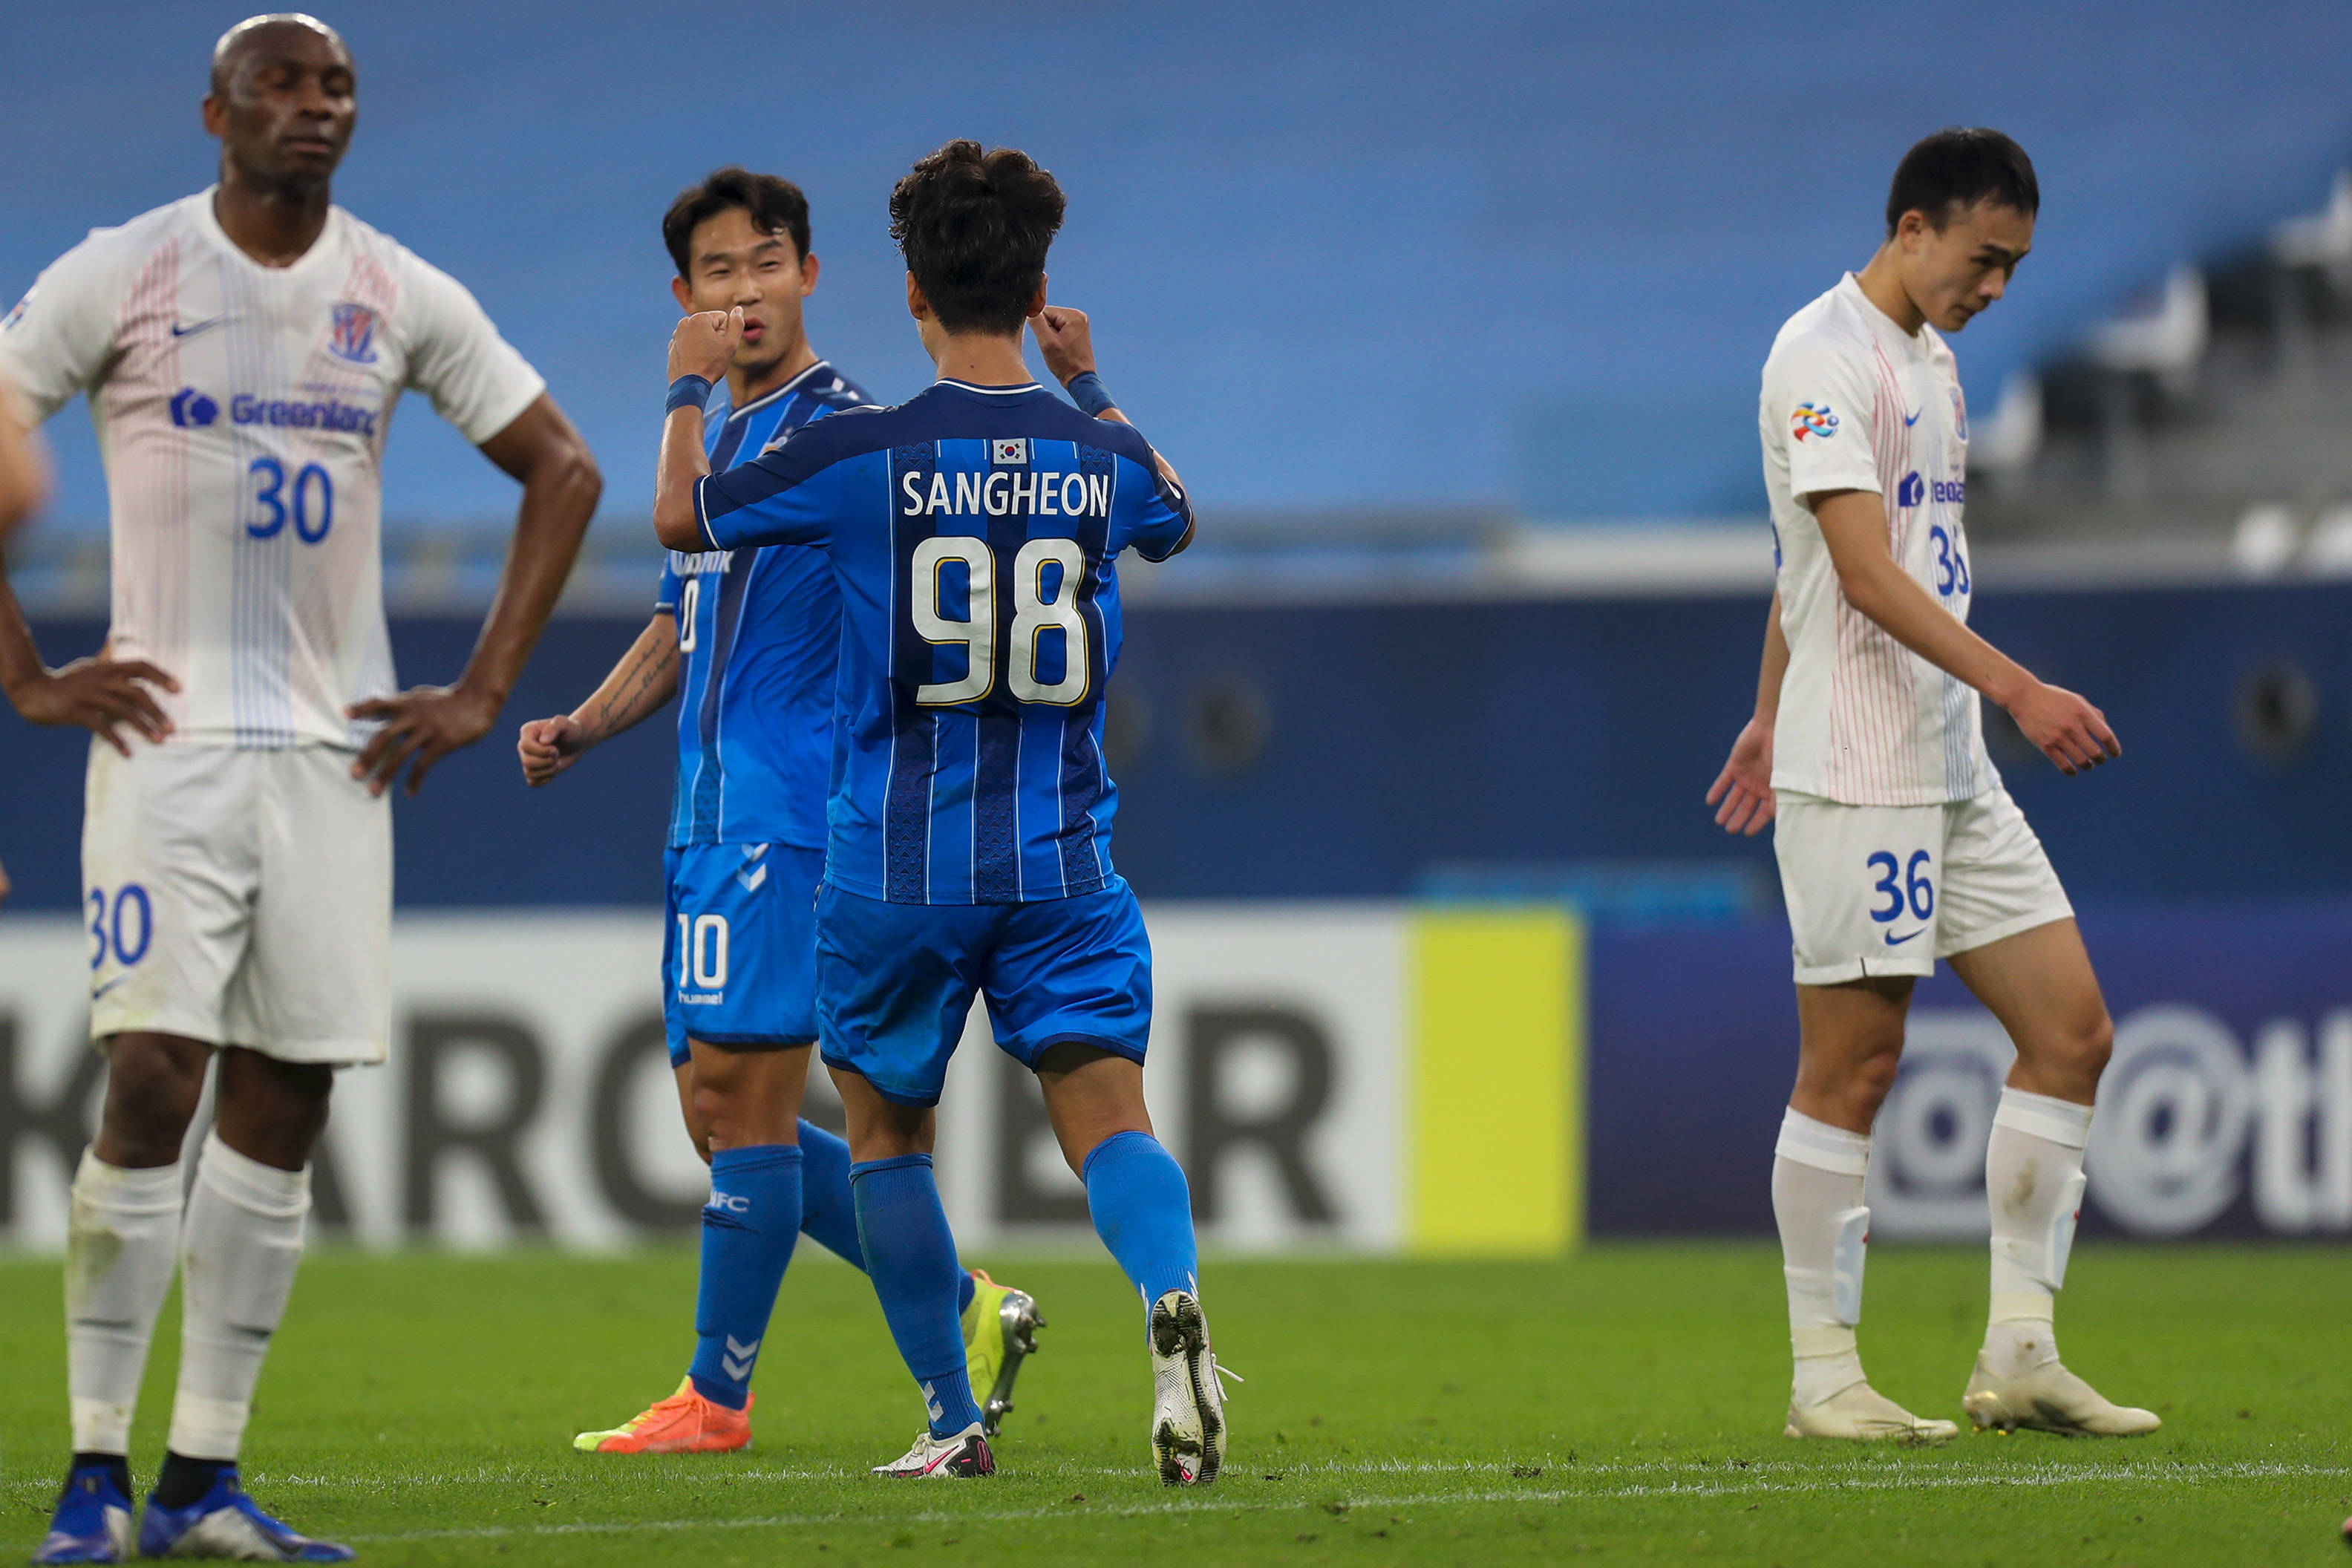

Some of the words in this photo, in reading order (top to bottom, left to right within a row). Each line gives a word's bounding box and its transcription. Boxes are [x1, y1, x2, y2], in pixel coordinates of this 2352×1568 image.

[246, 456, 333, 544] 30
[902, 471, 1108, 517] SANGHEON
[1930, 525, 1970, 596] 36
[912, 536, 1090, 707] 98
[1866, 849, 1933, 922] 36
[90, 883, 151, 970] 30
[677, 913, 729, 988] 10
[678, 990, 723, 1005] hummel
